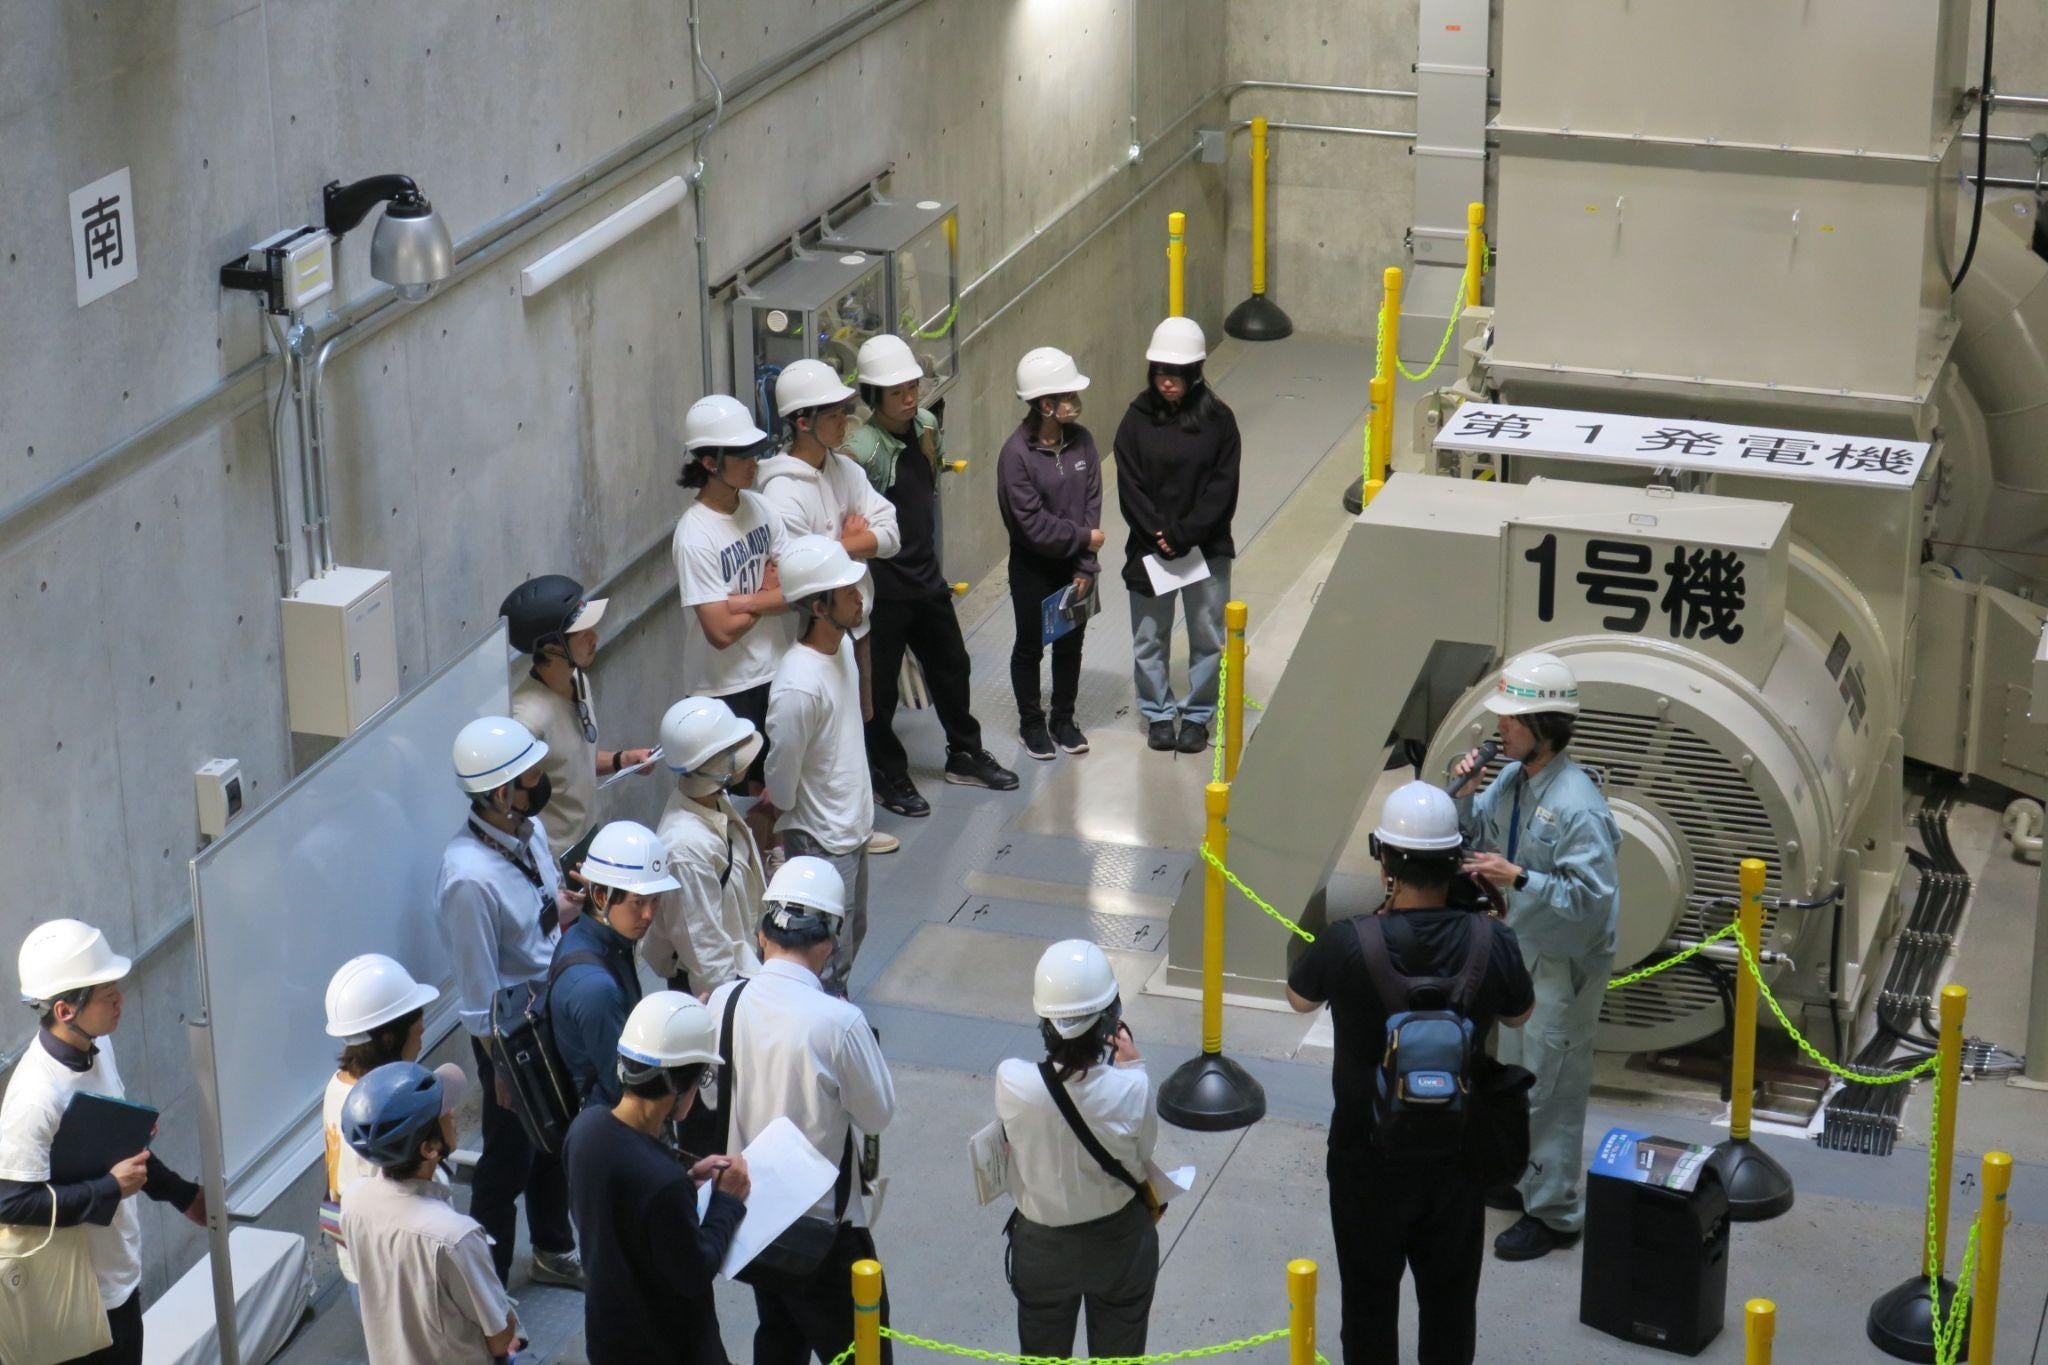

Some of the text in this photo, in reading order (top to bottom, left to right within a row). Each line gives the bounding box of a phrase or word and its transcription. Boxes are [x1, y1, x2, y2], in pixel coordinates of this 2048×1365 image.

[82, 194, 123, 279] 南
[1454, 410, 1914, 476] 第1発電機
[1524, 533, 1746, 645] 1号機
